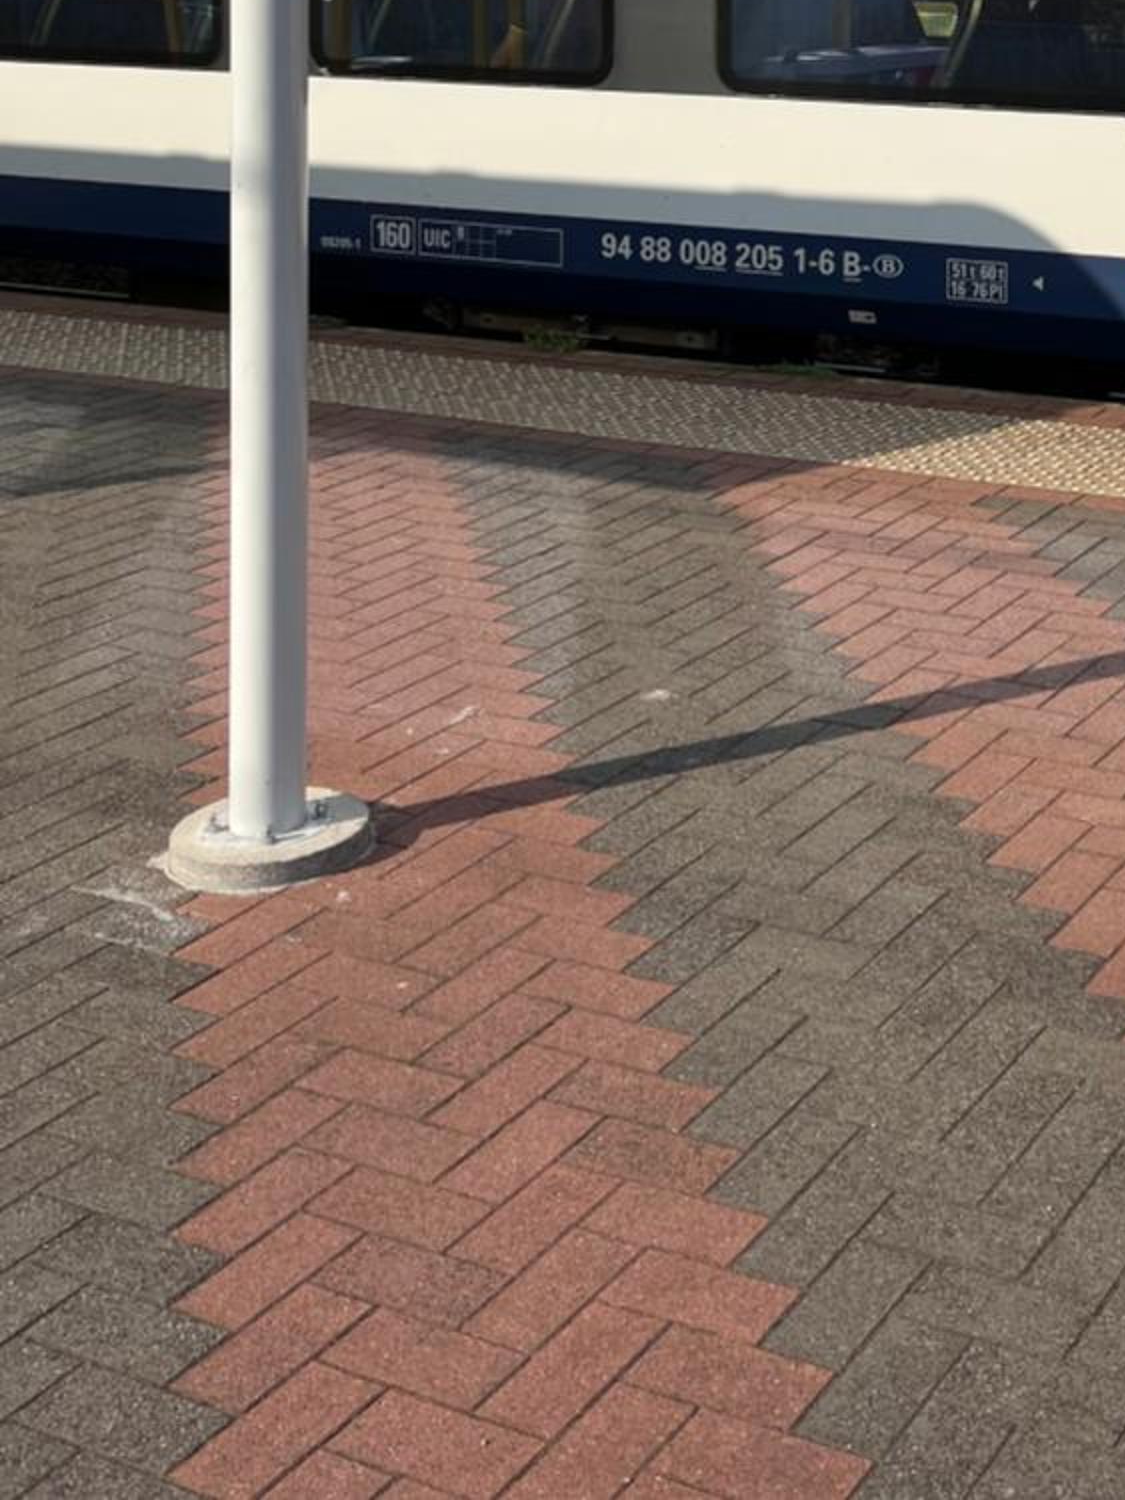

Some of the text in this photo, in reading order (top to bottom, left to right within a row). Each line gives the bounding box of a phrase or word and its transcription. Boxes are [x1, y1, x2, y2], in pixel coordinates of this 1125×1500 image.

[376, 221, 410, 249] 160
[424, 228, 450, 250] UIC
[601, 233, 633, 260] 94
[641, 236, 671, 262] 88
[680, 239, 727, 267] 008
[735, 243, 784, 271] 205
[793, 248, 835, 275] 1-6
